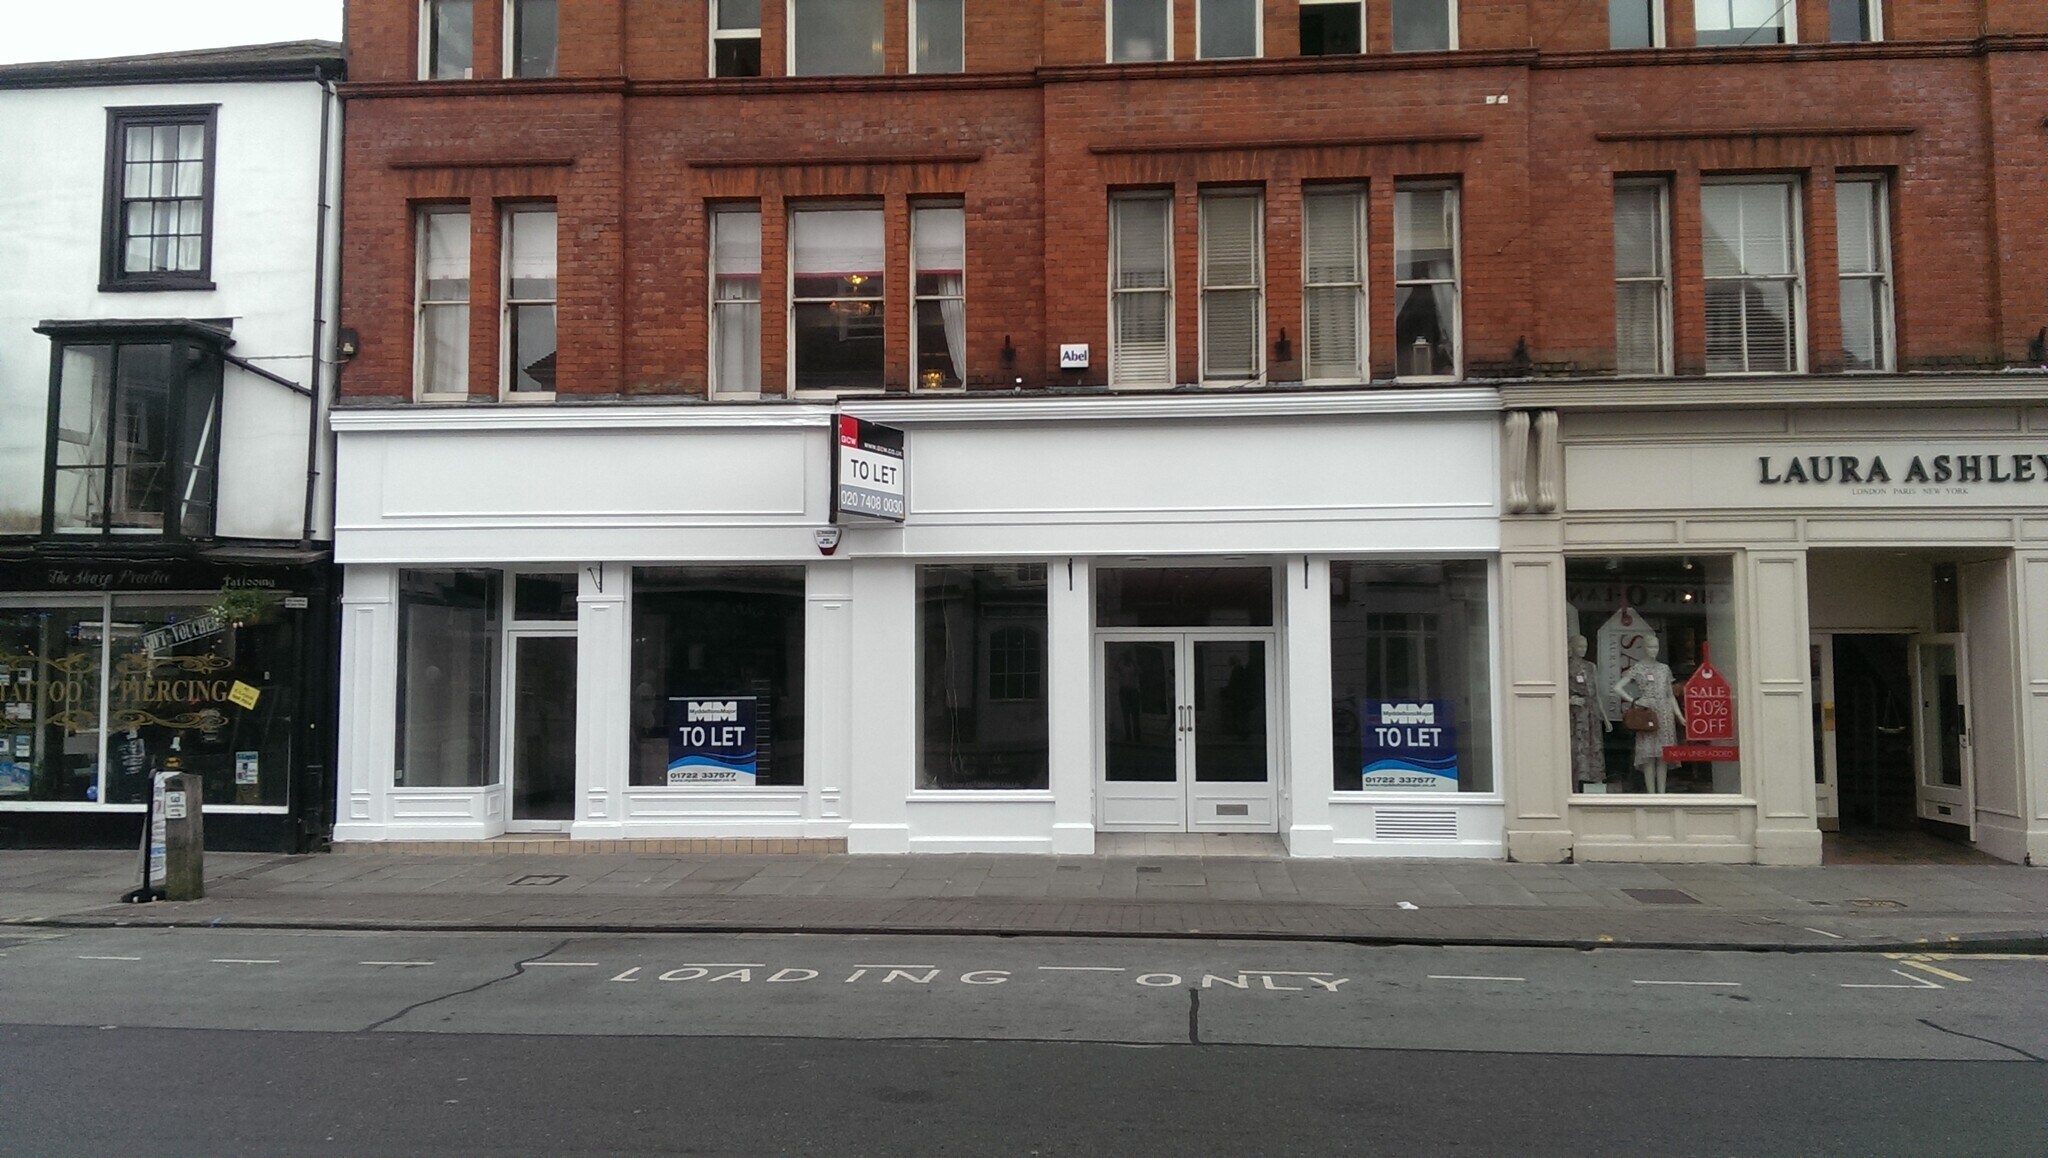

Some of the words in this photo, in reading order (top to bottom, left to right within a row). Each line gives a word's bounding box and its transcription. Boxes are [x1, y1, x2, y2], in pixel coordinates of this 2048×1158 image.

[1062, 350, 1087, 361] Abel
[841, 436, 857, 445] GCW
[851, 459, 869, 480] TO
[874, 464, 897, 485] LET
[1759, 455, 1892, 484] LAURA
[842, 490, 858, 506] 020
[860, 494, 881, 510] 7408
[883, 499, 903, 513] 0030
[48, 569, 70, 584] The
[121, 680, 229, 702] PIERCING
[1690, 687, 1725, 697] SALE
[688, 701, 737, 722] MM
[1381, 704, 1434, 724] MM
[1693, 700, 1728, 715] 50%
[679, 726, 705, 746] TO
[711, 726, 745, 746] LET
[1691, 719, 1726, 734] OFF
[1375, 728, 1401, 747] TO
[1407, 728, 1442, 747] LET
[611, 966, 1012, 986] LOADING
[1136, 972, 1352, 992] ONLY
